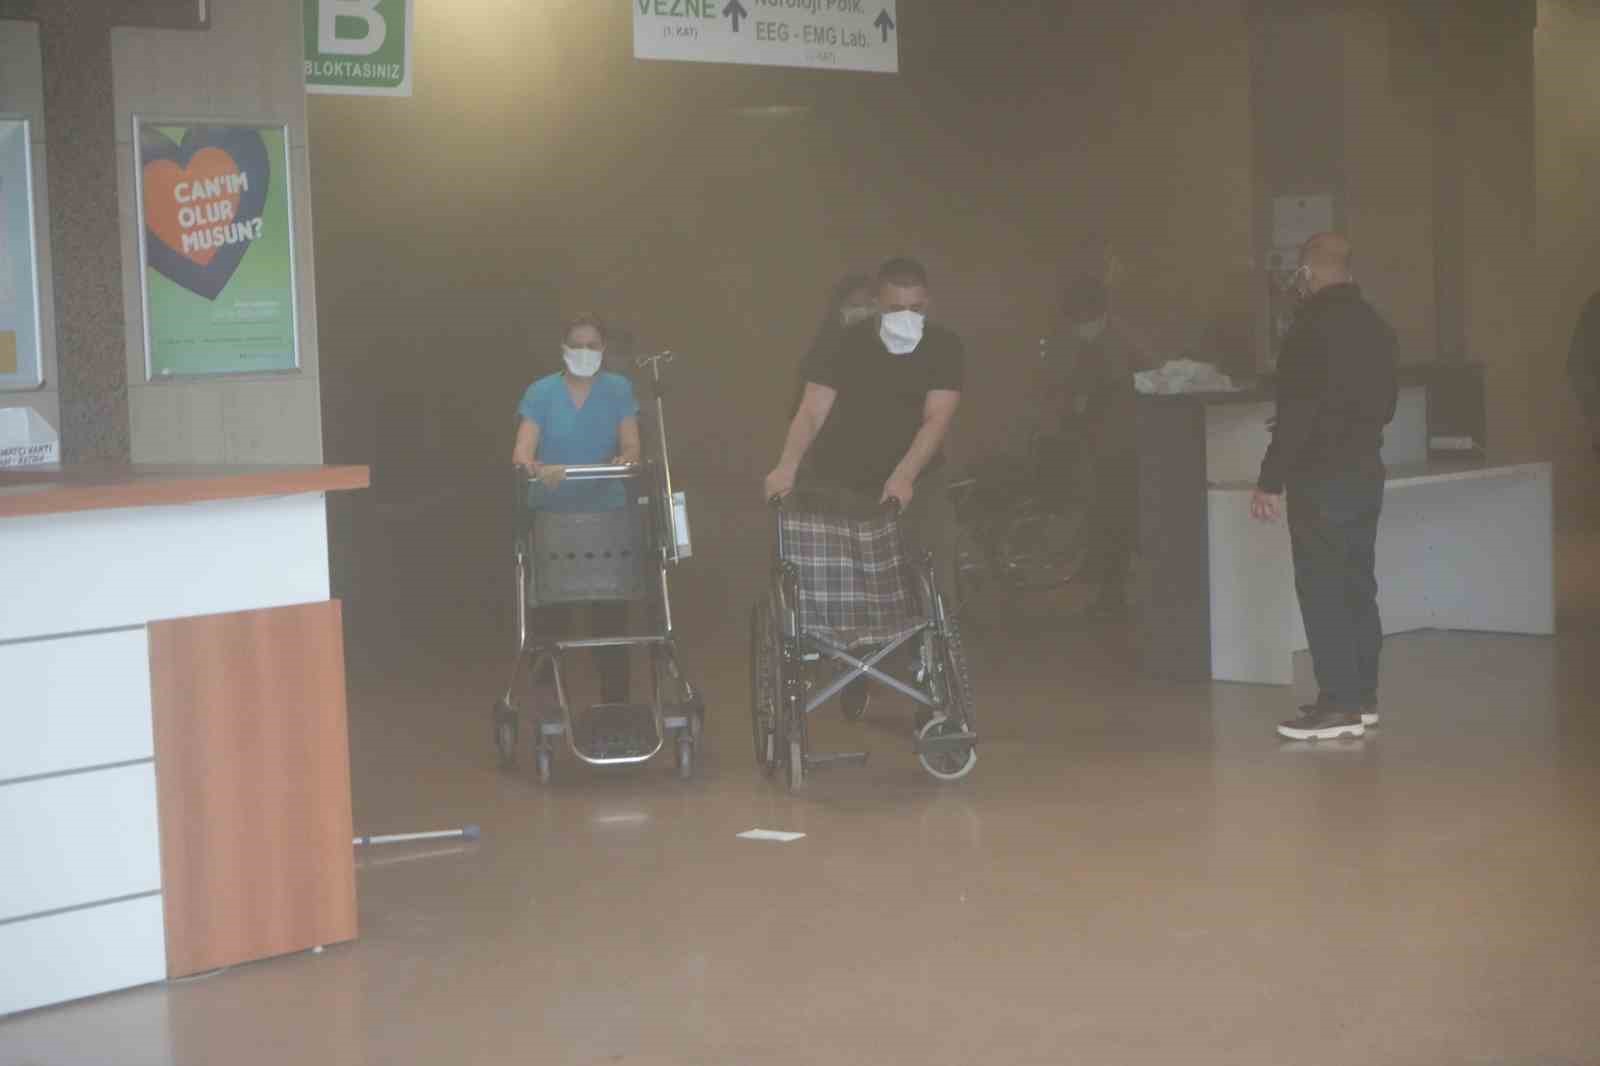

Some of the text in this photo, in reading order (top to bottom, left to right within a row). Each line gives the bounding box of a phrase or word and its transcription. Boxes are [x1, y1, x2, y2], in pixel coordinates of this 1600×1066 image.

[318, 0, 387, 56] B
[755, 21, 790, 42] EEG
[802, 24, 838, 46] EMG
[840, 27, 871, 49] Lab.
[173, 171, 249, 204] CAN'IM
[178, 199, 234, 228] OLUR
[181, 217, 264, 255] MUSUN?
